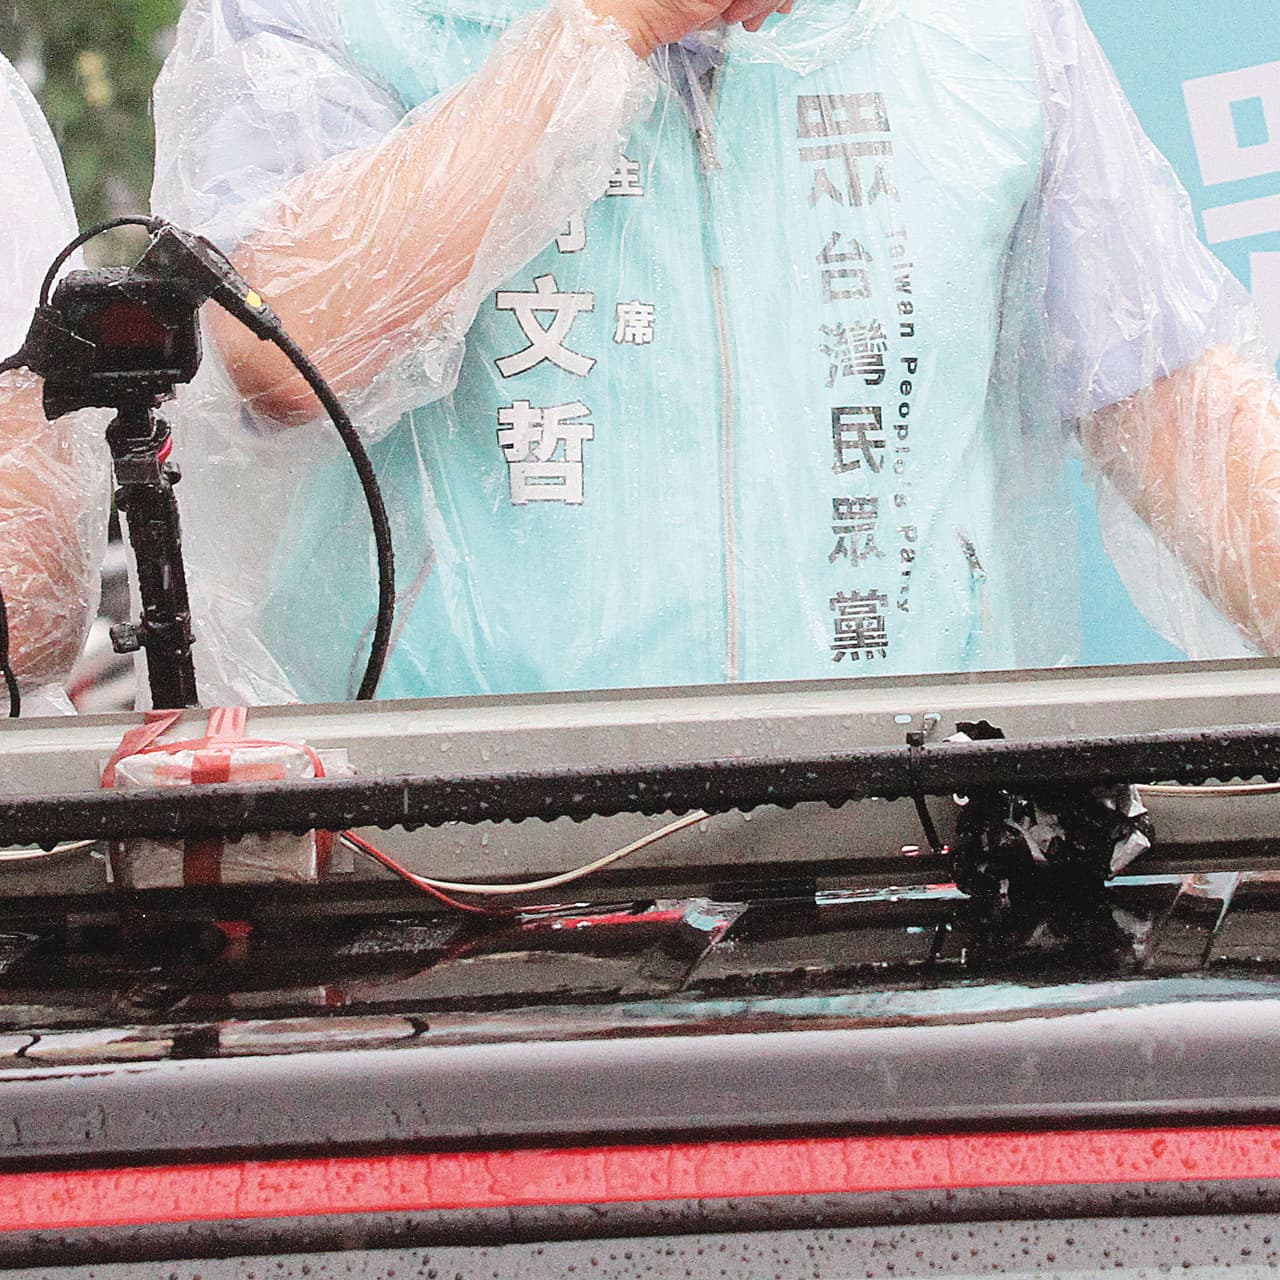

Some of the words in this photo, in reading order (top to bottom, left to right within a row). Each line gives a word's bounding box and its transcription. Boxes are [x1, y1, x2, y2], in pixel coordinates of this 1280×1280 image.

[795, 91, 902, 208] 眾
[494, 209, 597, 507] 文哲
[814, 230, 890, 663] 台灣民眾黨
